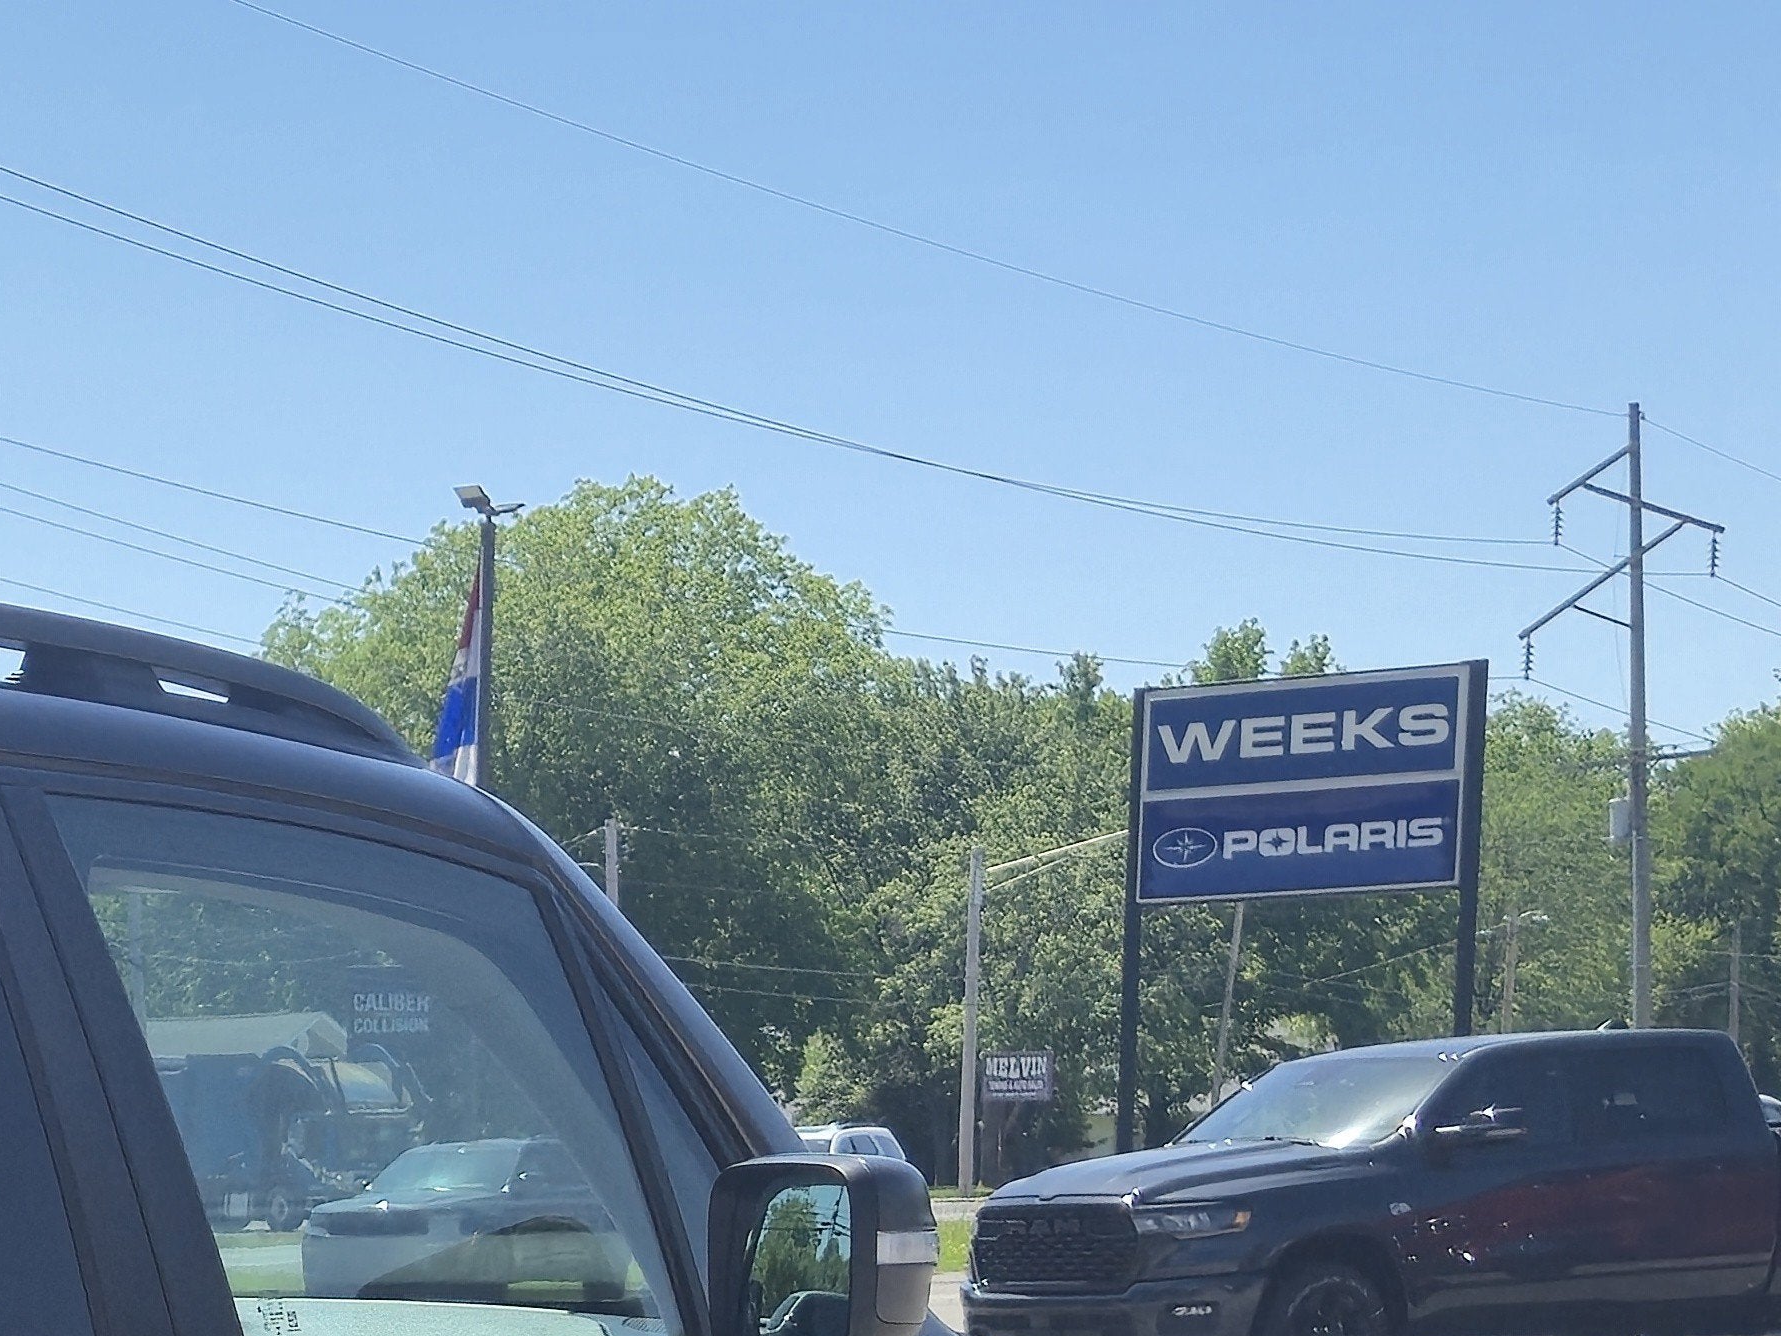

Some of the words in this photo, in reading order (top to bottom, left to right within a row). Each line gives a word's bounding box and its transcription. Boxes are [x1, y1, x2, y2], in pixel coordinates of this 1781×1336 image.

[1157, 702, 1450, 764] WEEKS
[1222, 816, 1444, 860] POLARIS
[985, 1055, 1048, 1079] MELVIN
